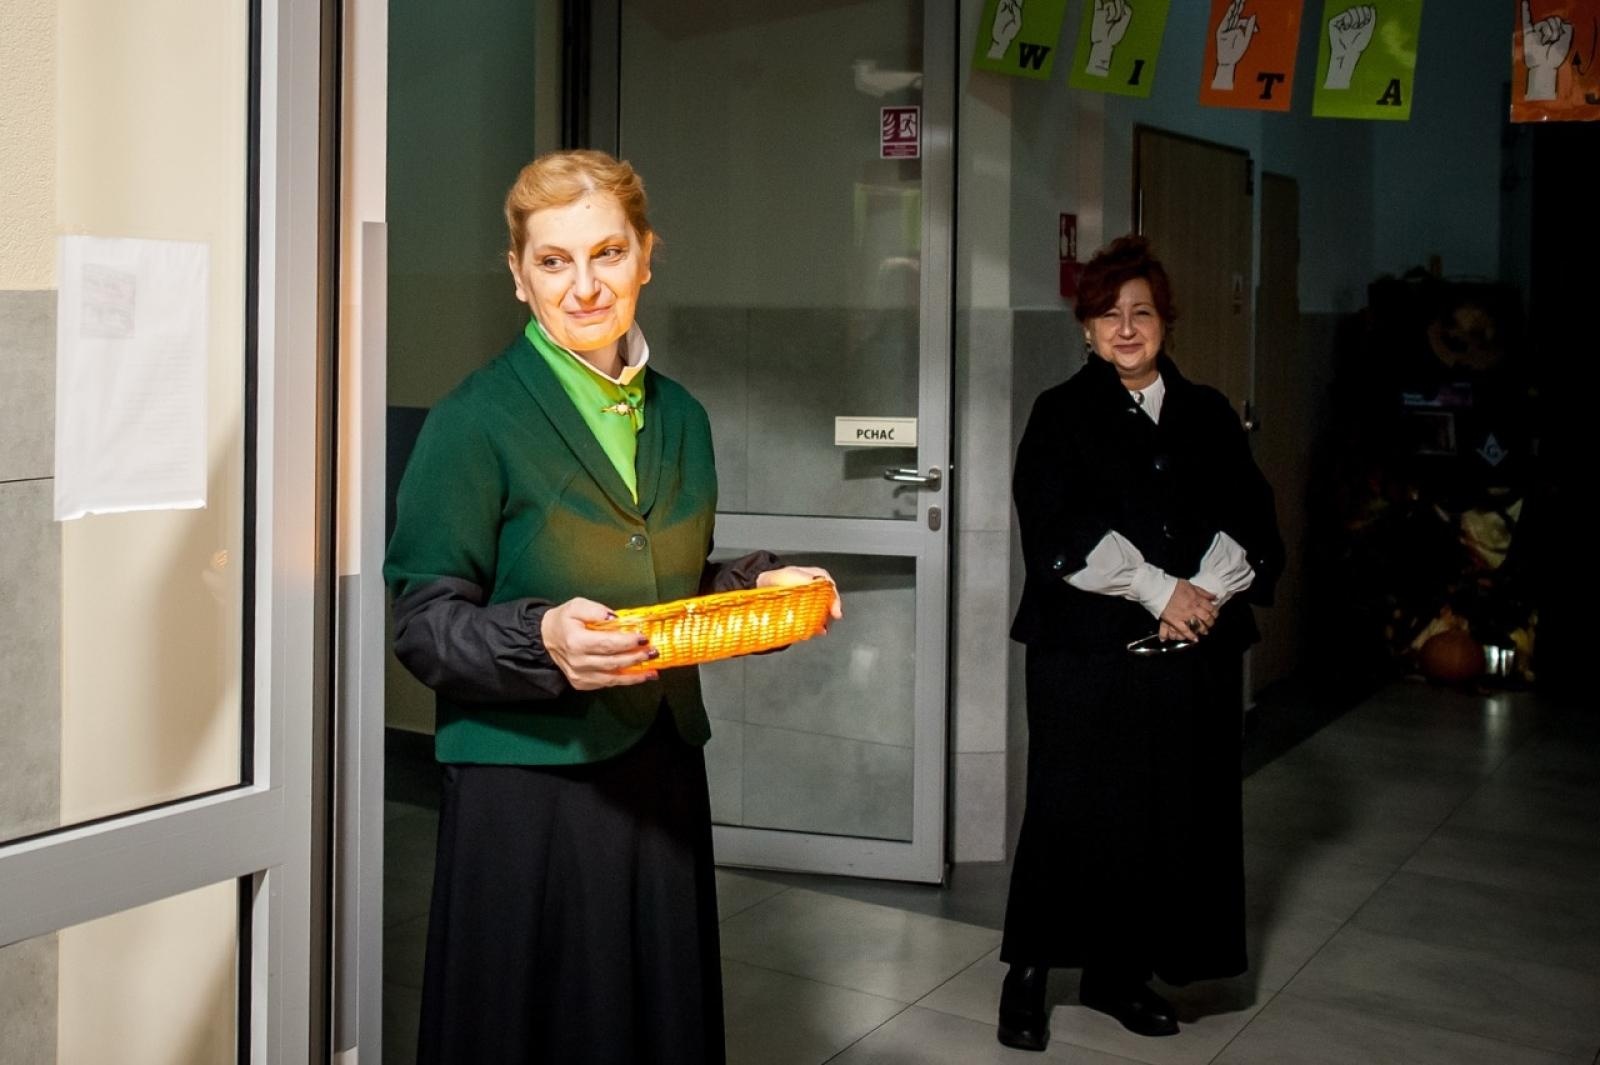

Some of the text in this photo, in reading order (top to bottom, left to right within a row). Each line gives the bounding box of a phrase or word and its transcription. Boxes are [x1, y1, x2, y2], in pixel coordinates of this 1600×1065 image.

[1019, 42, 1402, 106] W I T A
[856, 428, 895, 440] PCHAĆ
